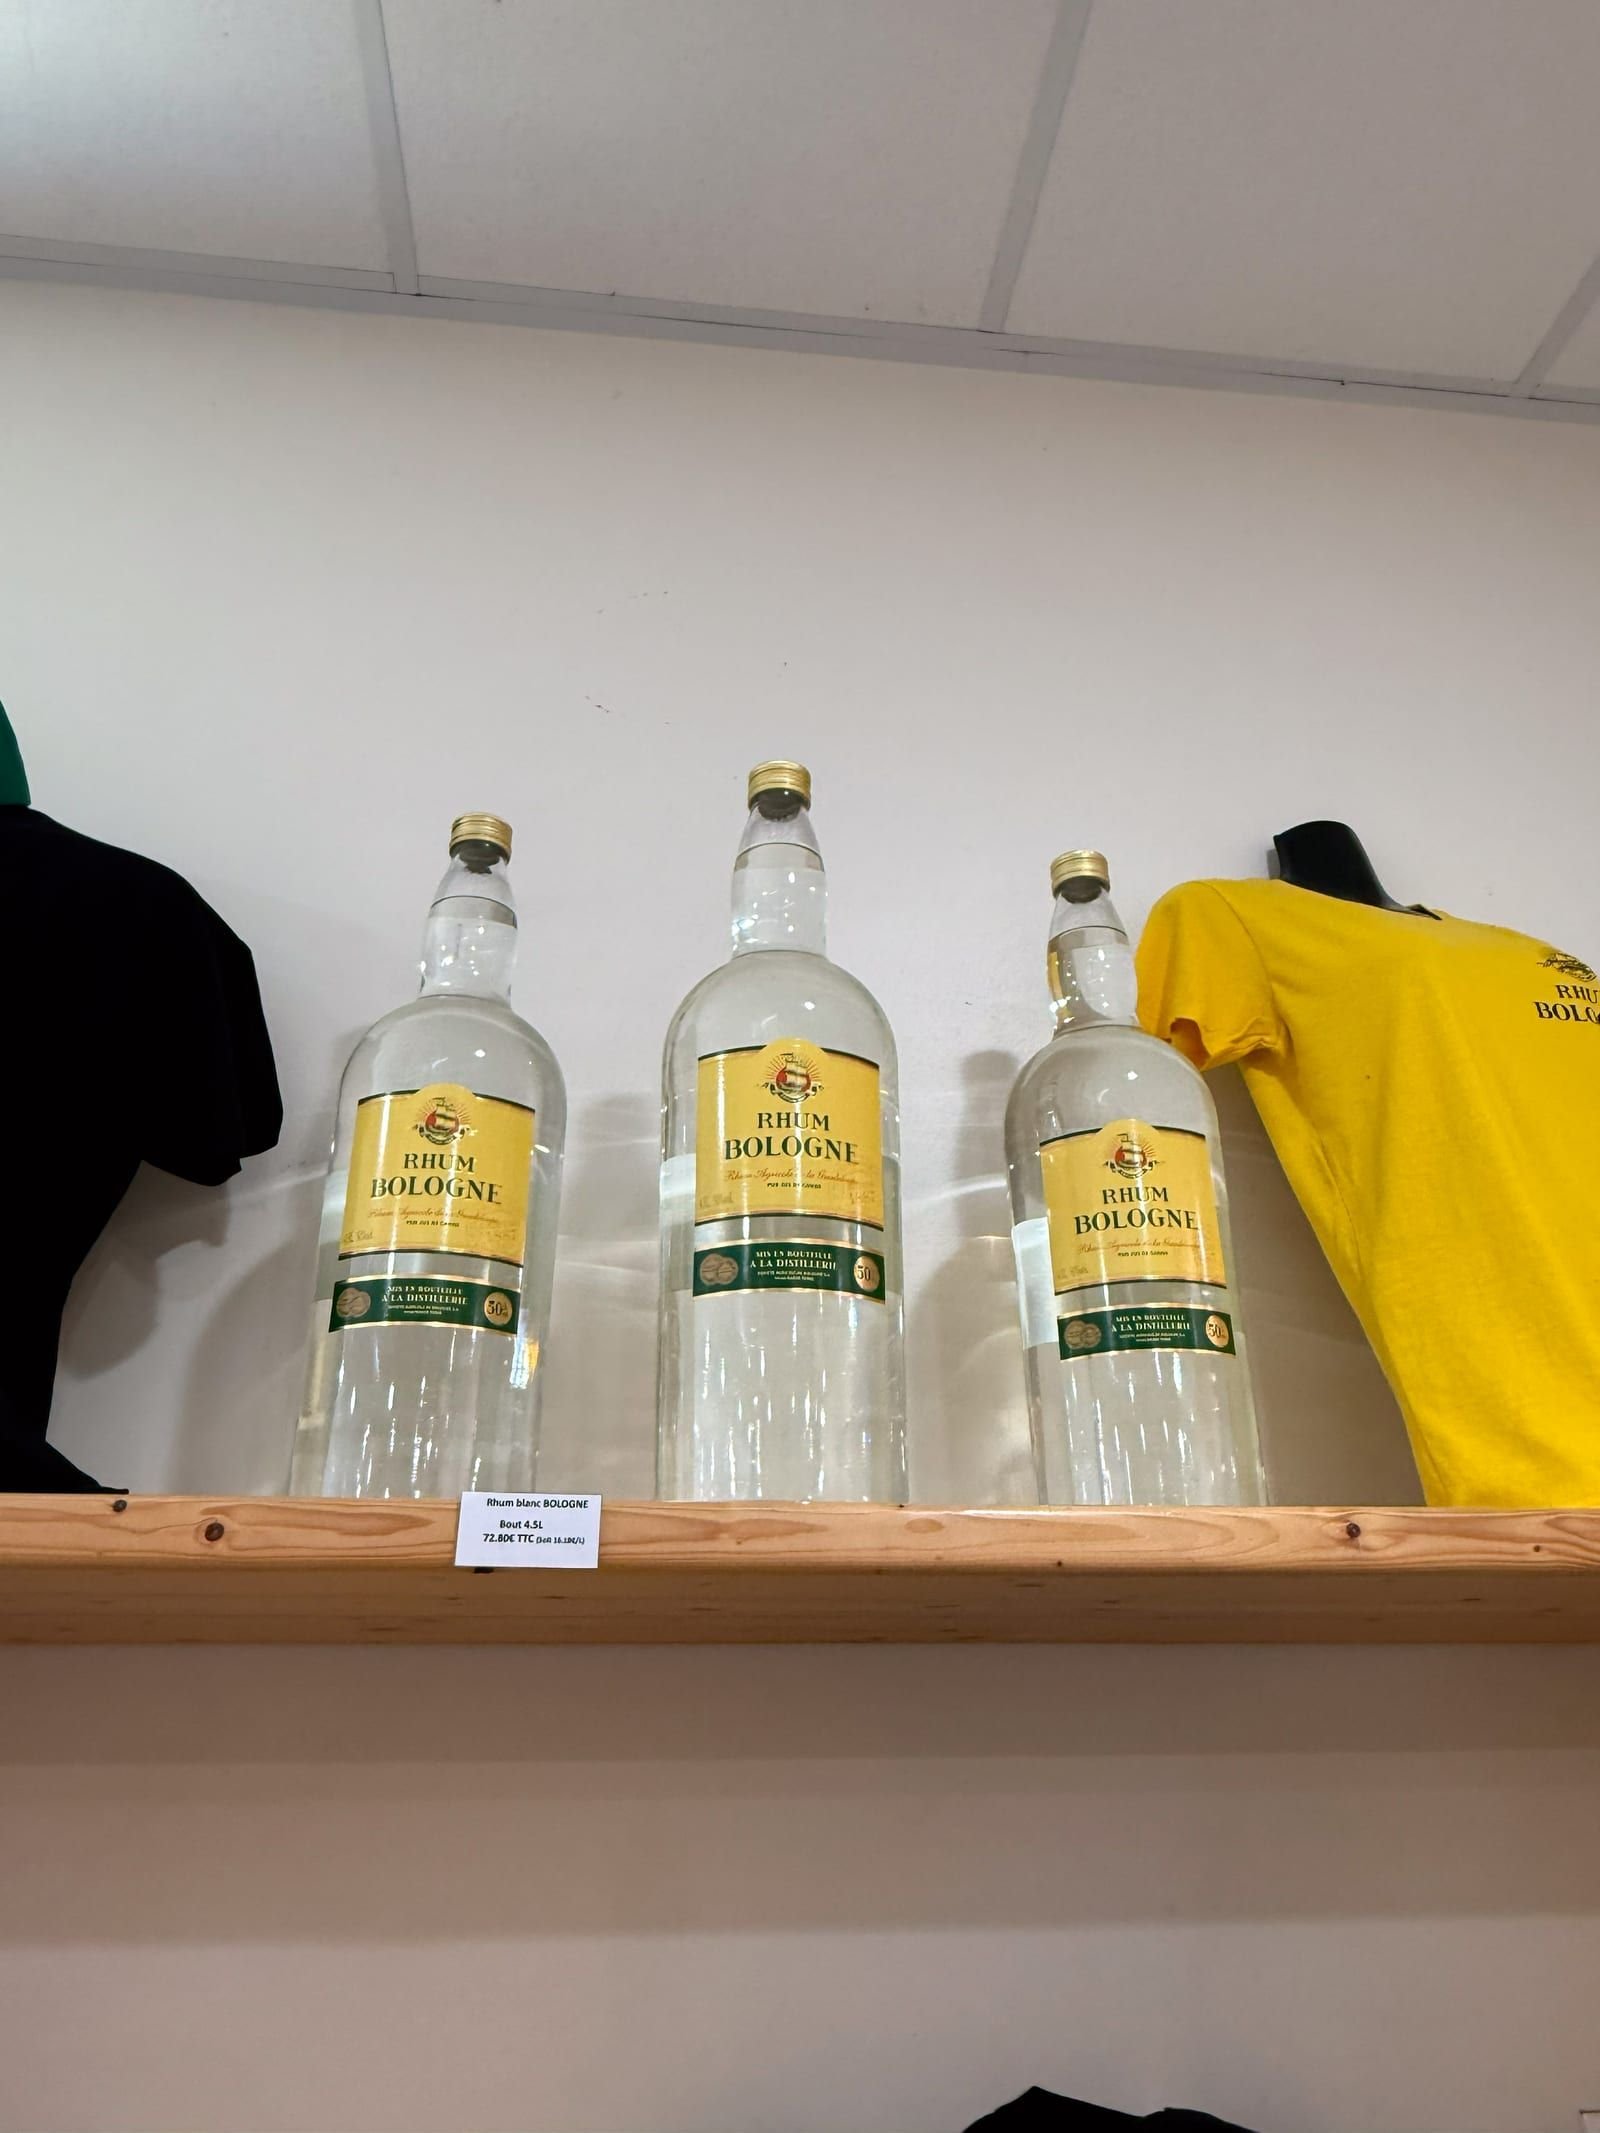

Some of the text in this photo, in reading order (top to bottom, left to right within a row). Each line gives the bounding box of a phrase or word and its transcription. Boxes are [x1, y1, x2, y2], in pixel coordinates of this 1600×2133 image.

[1555, 984, 1600, 1004] RHU
[1533, 1001, 1600, 1025] BOLO
[757, 1112, 830, 1131] RHUM
[725, 1135, 859, 1165] BOLOGNE
[403, 1153, 475, 1173] RHUM
[370, 1175, 503, 1205] BOLOGNE
[1102, 1186, 1169, 1205] RHUM
[1074, 1208, 1198, 1235] BOLOGNE
[760, 1259, 773, 1268] LA
[857, 1265, 871, 1281] 50
[391, 1294, 403, 1302] LA
[1120, 1323, 1132, 1331] LA
[486, 1498, 589, 1509] Rhum blanc BOLOGNE
[499, 1519, 544, 1529] Bout 4.5L
[483, 1533, 515, 1543] 72.80€
[517, 1534, 535, 1543] TTC
